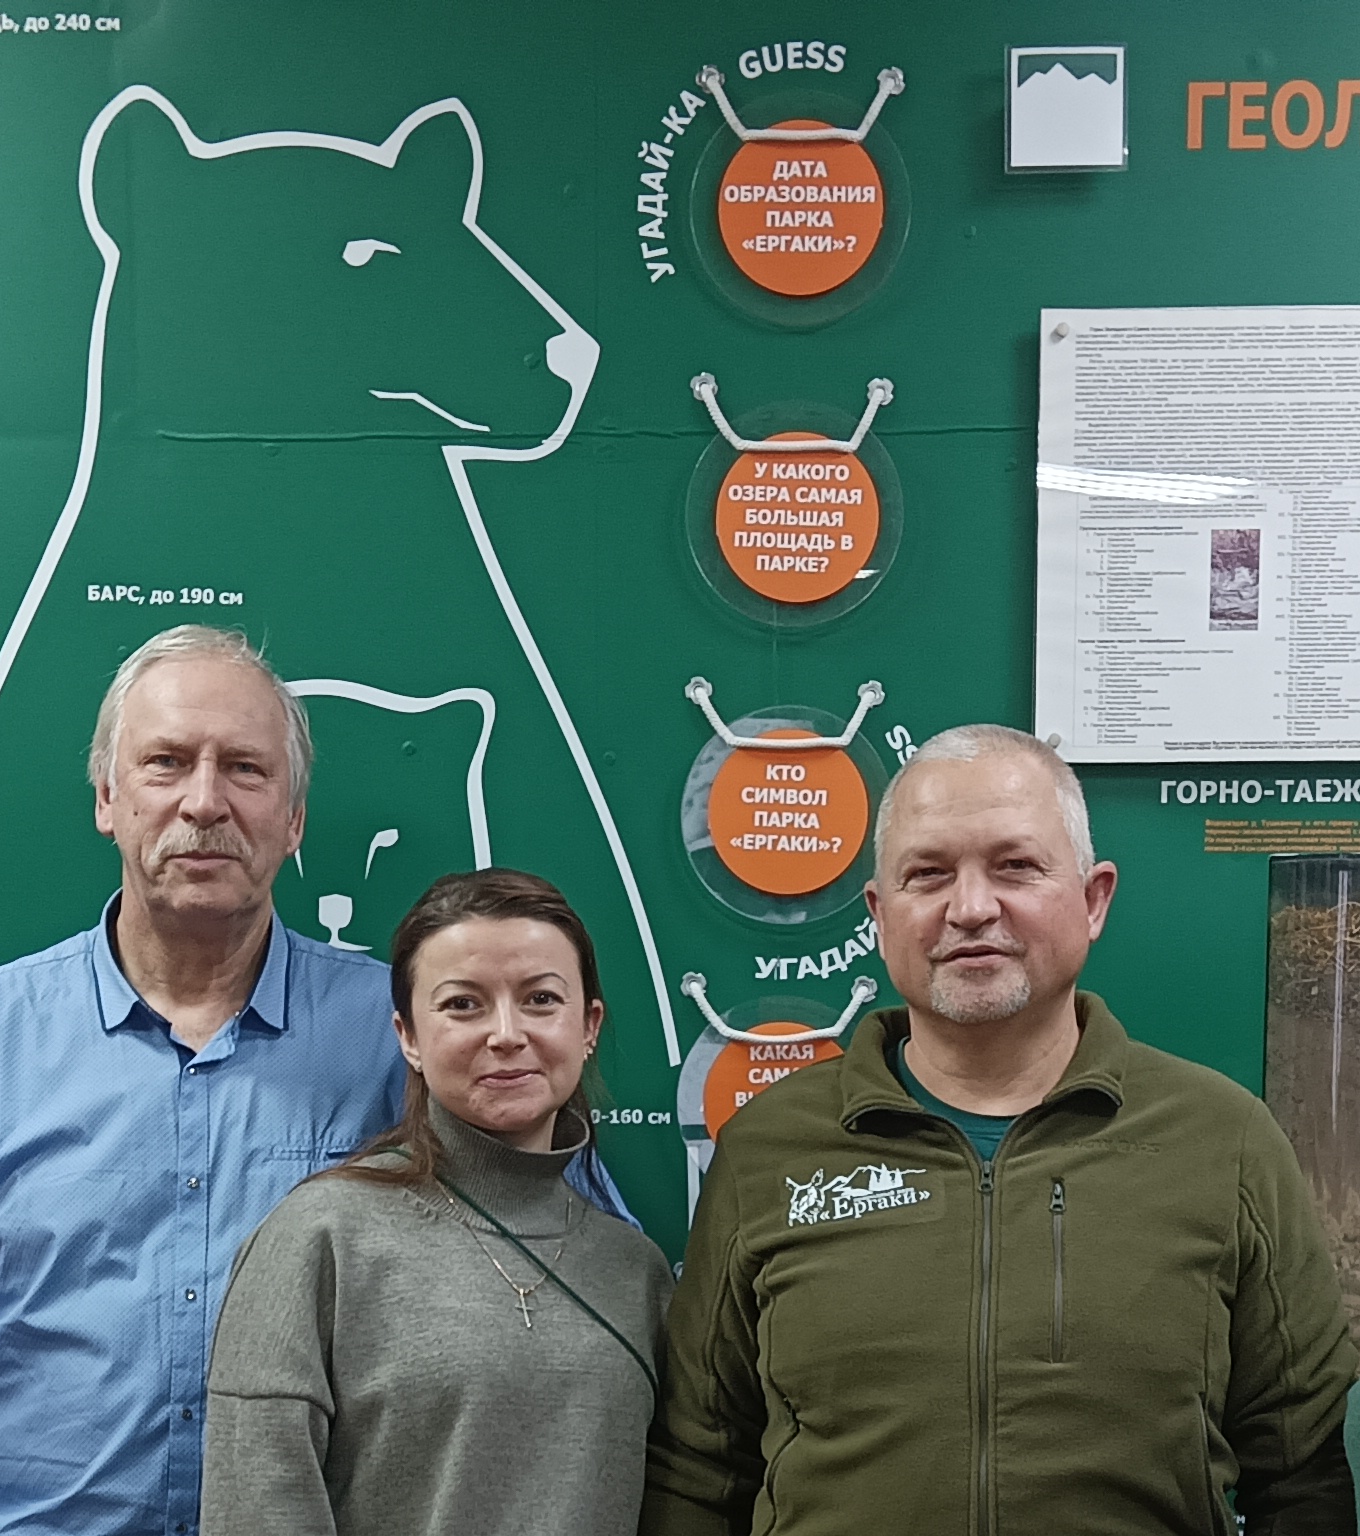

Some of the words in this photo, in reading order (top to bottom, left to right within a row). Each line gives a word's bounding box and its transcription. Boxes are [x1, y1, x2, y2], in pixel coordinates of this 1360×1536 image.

[23, 16, 50, 33] до
[54, 13, 91, 31] 240
[94, 17, 121, 32] см
[738, 39, 847, 80] GUESS
[772, 160, 828, 181] ДАТА
[636, 88, 708, 285] УГАДАЙ-КА
[724, 185, 876, 203] ОБРАЗОВАНИЯ
[766, 210, 834, 228] ПАРКА
[742, 235, 857, 253] «ЕРГАКИ»?
[754, 462, 768, 479] У
[772, 463, 850, 482] КАКОГО
[728, 484, 791, 503] ОЗЕРА
[795, 486, 863, 505] САМАЯ
[745, 508, 844, 527] БОЛЬШАЯ
[734, 531, 836, 553] ПЛОЩАДЬ
[840, 534, 854, 551] В
[756, 554, 830, 573] ПАРКЕ?
[87, 584, 146, 605] БАРС,
[149, 589, 175, 606] до
[179, 587, 215, 605] 190
[218, 591, 243, 605] см
[766, 764, 806, 782] КТО
[741, 786, 828, 806] СИМВОЛ
[754, 810, 820, 829] ПАРКА
[729, 833, 843, 853] «ЕРГАКИ»?
[749, 1042, 815, 1062] КАКАЯ
[747, 1067, 801, 1085] САМ
[647, 1112, 671, 1125] см
[819, 1186, 931, 1221] «Ергаки»
